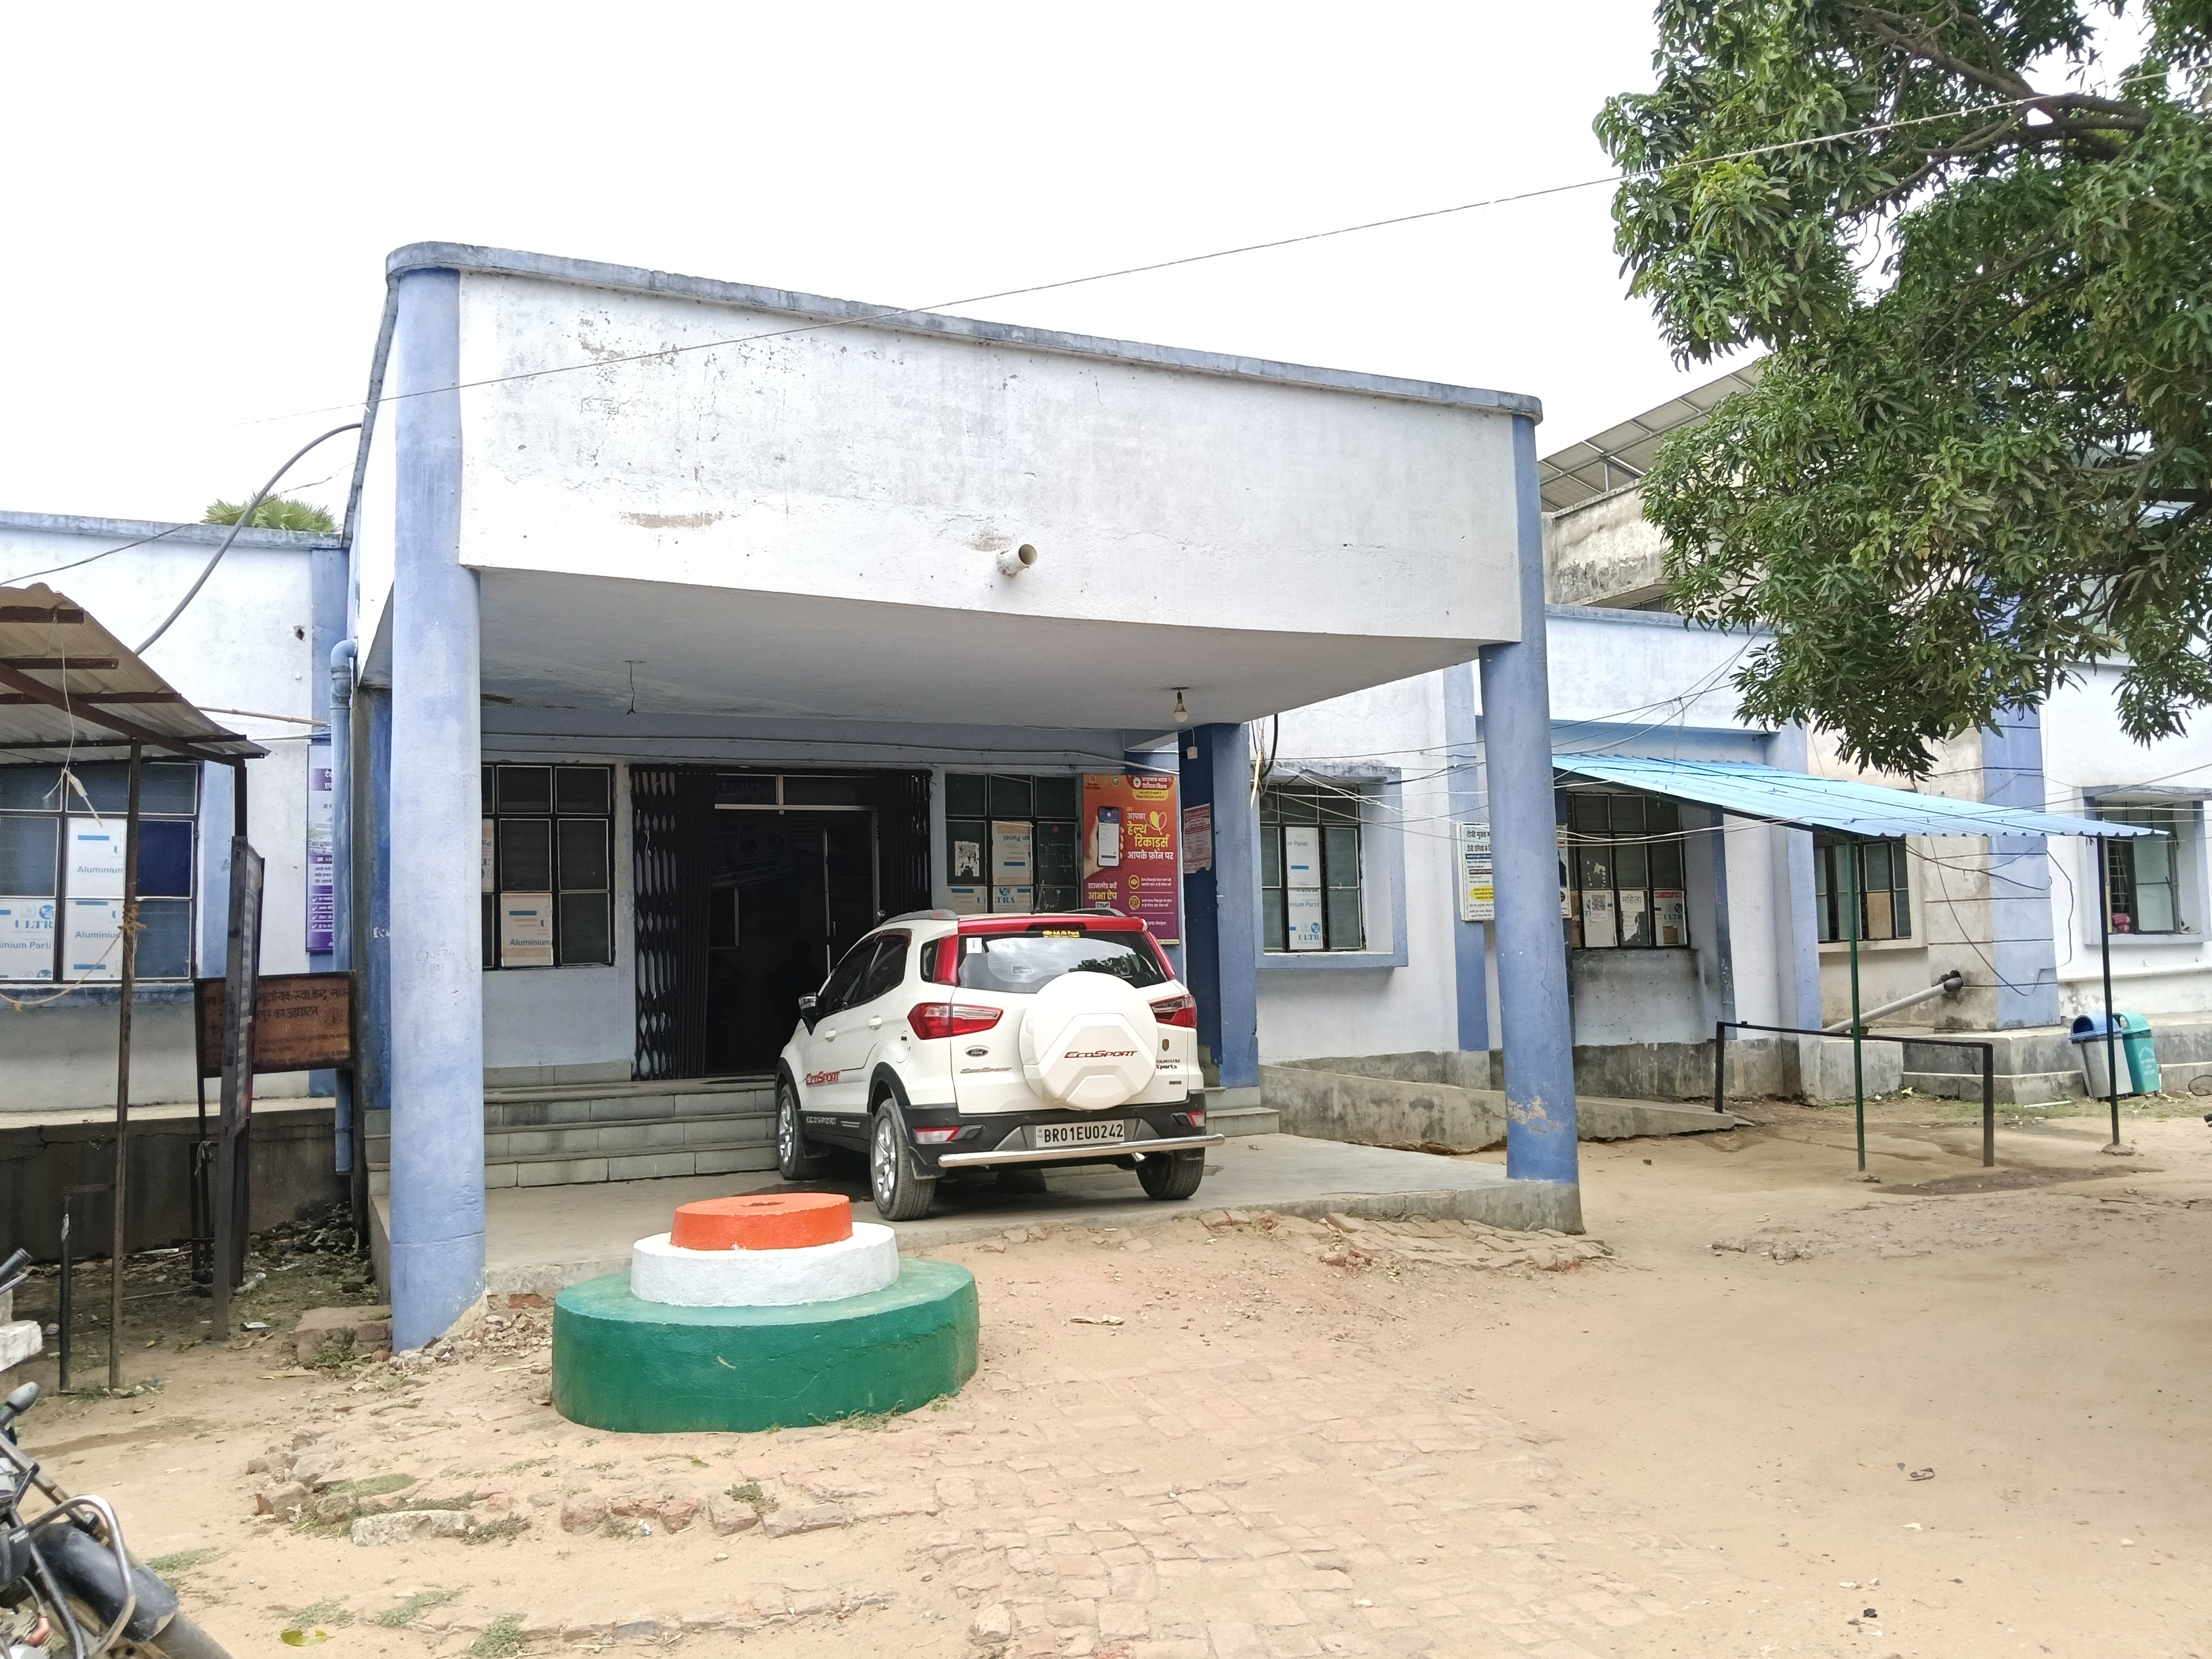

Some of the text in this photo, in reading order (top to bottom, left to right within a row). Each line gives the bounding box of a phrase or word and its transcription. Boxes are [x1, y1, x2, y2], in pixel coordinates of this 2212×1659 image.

[1127, 821, 1147, 835] हेल्थ
[1128, 849, 1148, 860] आपके
[1165, 852, 1174, 860] पर
[1088, 890, 1117, 900] आभा ऐप
[1622, 894, 1642, 905] महिला
[806, 1116, 837, 1125] ECOSPORT
[1044, 1124, 1123, 1143] BR01EU0242
